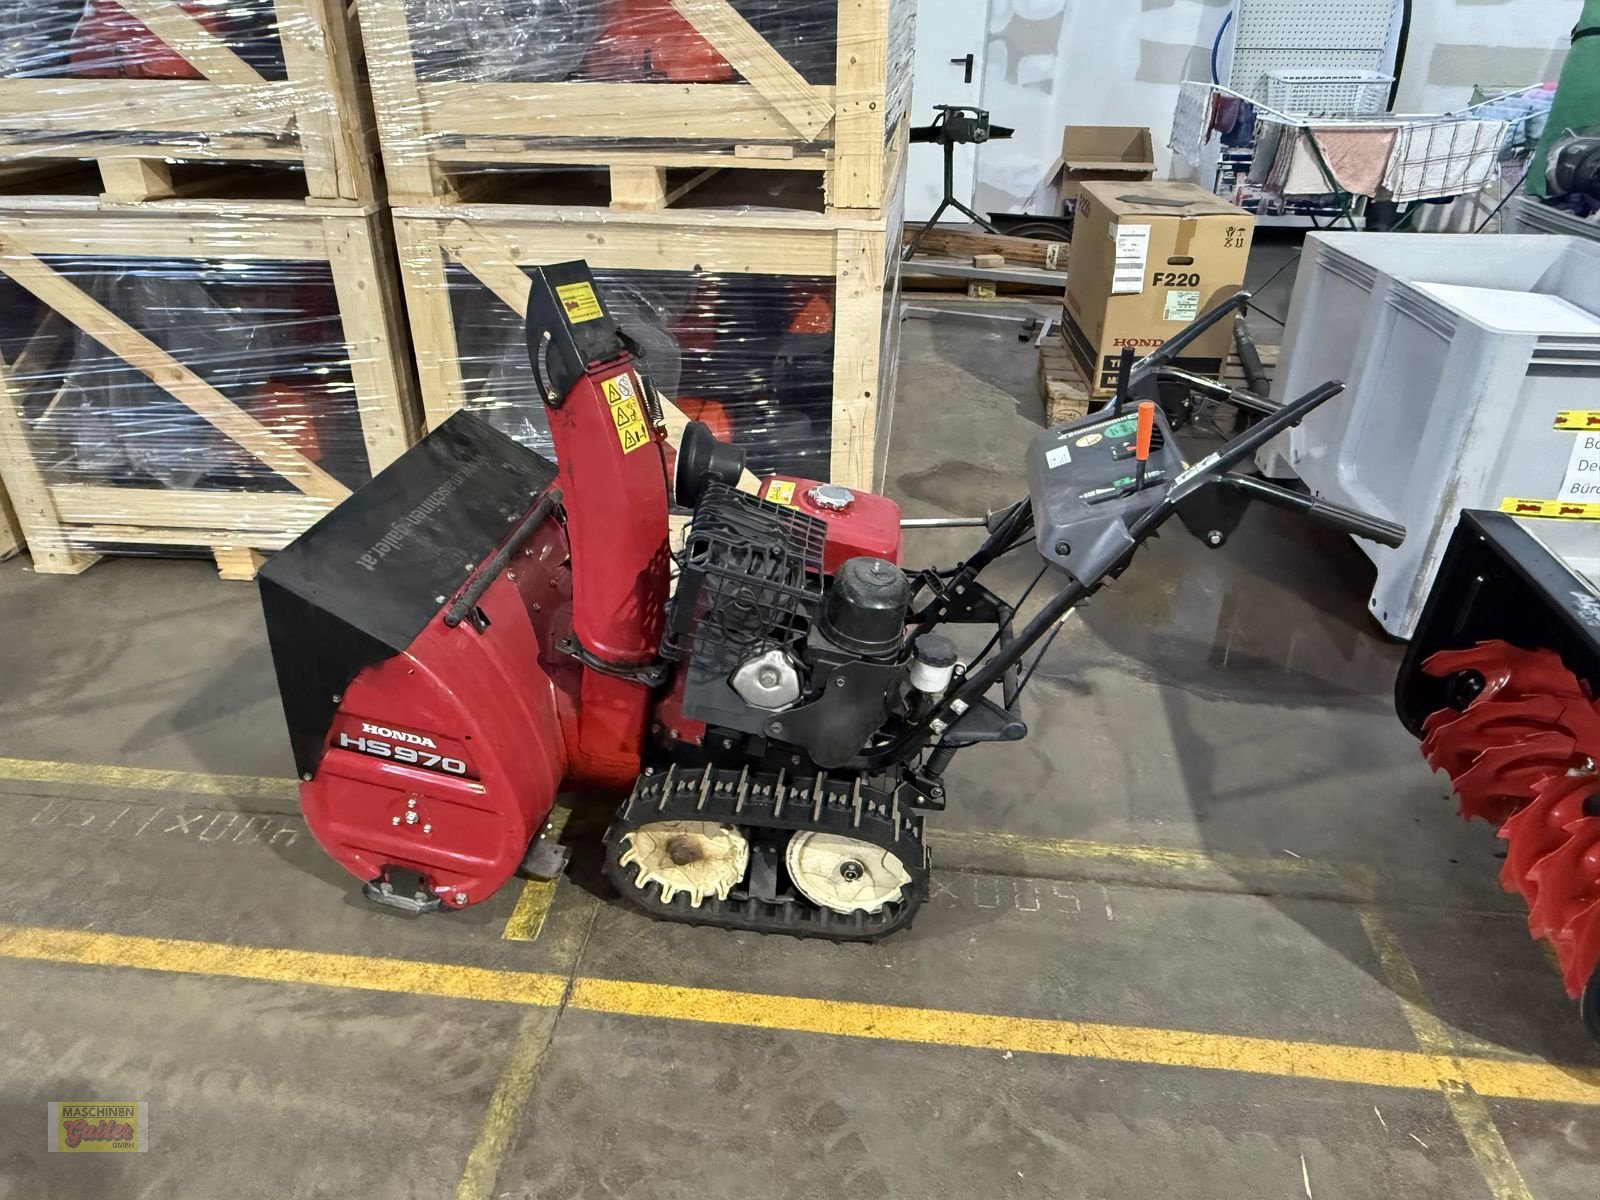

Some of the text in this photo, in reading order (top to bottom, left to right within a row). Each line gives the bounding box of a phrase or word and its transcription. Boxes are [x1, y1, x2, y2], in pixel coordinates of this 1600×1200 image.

[1152, 272, 1201, 288] F220
[1112, 338, 1165, 348] HOND
[1578, 459, 1600, 471] De
[361, 722, 438, 749] HONDA
